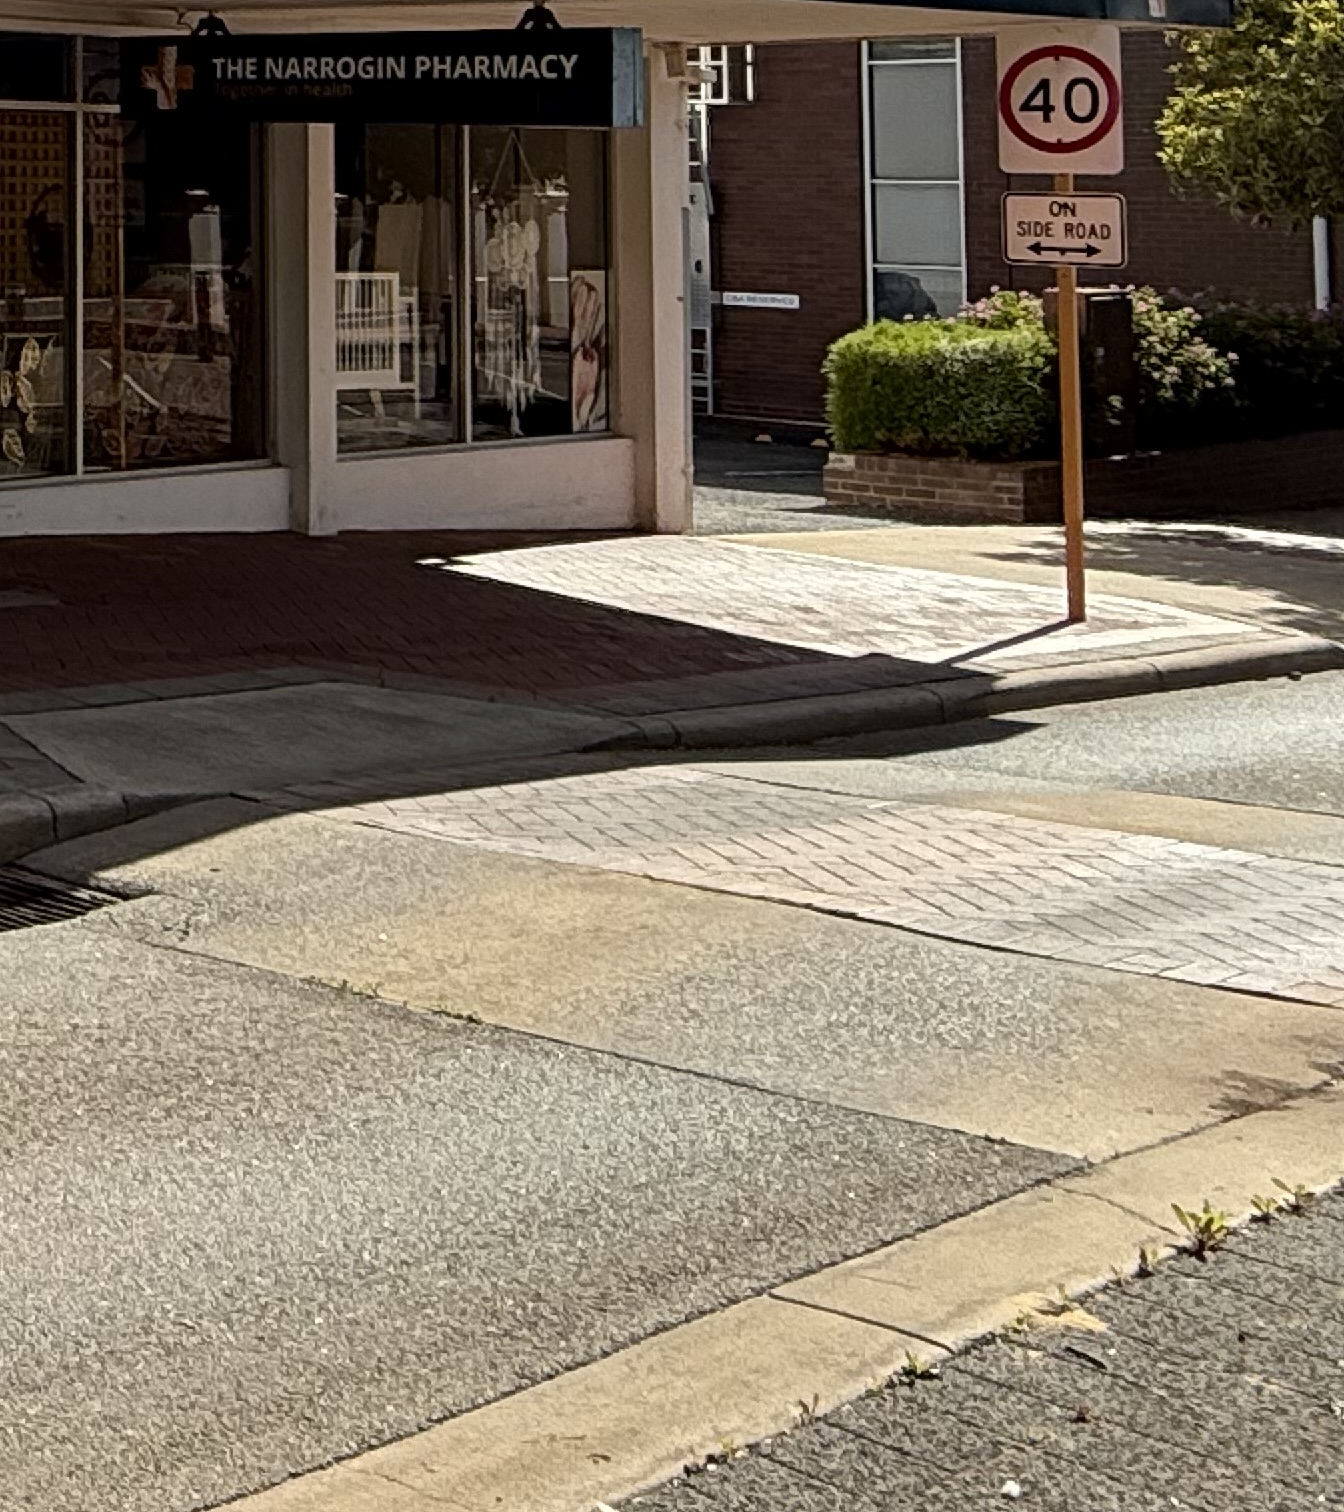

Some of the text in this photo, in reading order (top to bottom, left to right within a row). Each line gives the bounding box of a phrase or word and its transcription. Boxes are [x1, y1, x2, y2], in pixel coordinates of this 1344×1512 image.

[213, 54, 579, 80] THE NARROGIN PHARMACY
[1019, 77, 1100, 123] 40
[1049, 200, 1078, 218] ON
[1017, 221, 1111, 239] SIDE ROAD
